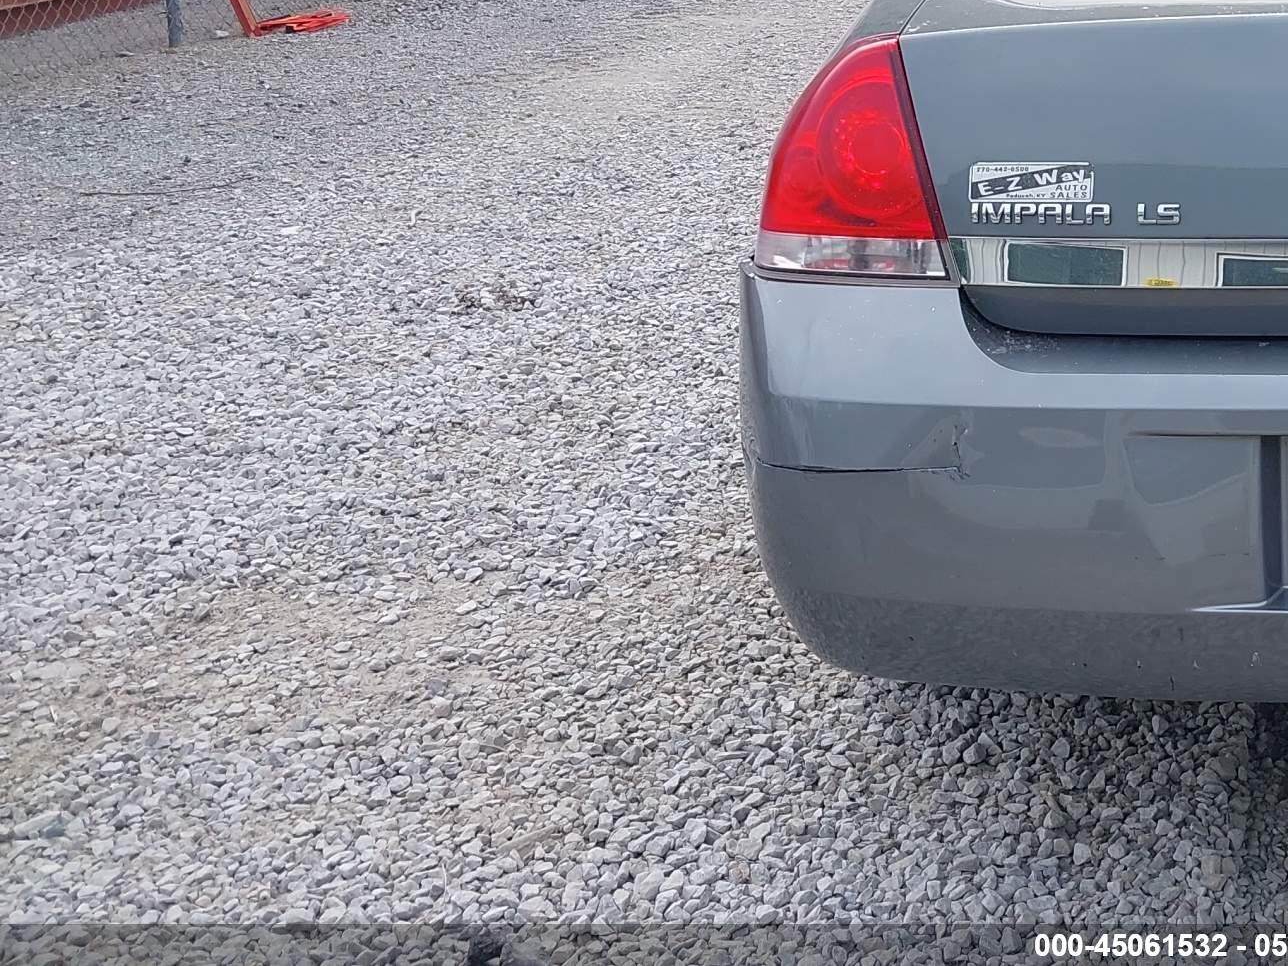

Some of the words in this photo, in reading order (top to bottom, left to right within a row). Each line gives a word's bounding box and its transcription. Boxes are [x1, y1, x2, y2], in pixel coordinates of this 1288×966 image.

[977, 176, 1023, 196] E-Z
[1033, 169, 1086, 186] Way
[1049, 191, 1088, 199] SALES
[971, 203, 1111, 225] IMPALA
[1137, 203, 1181, 225] LS
